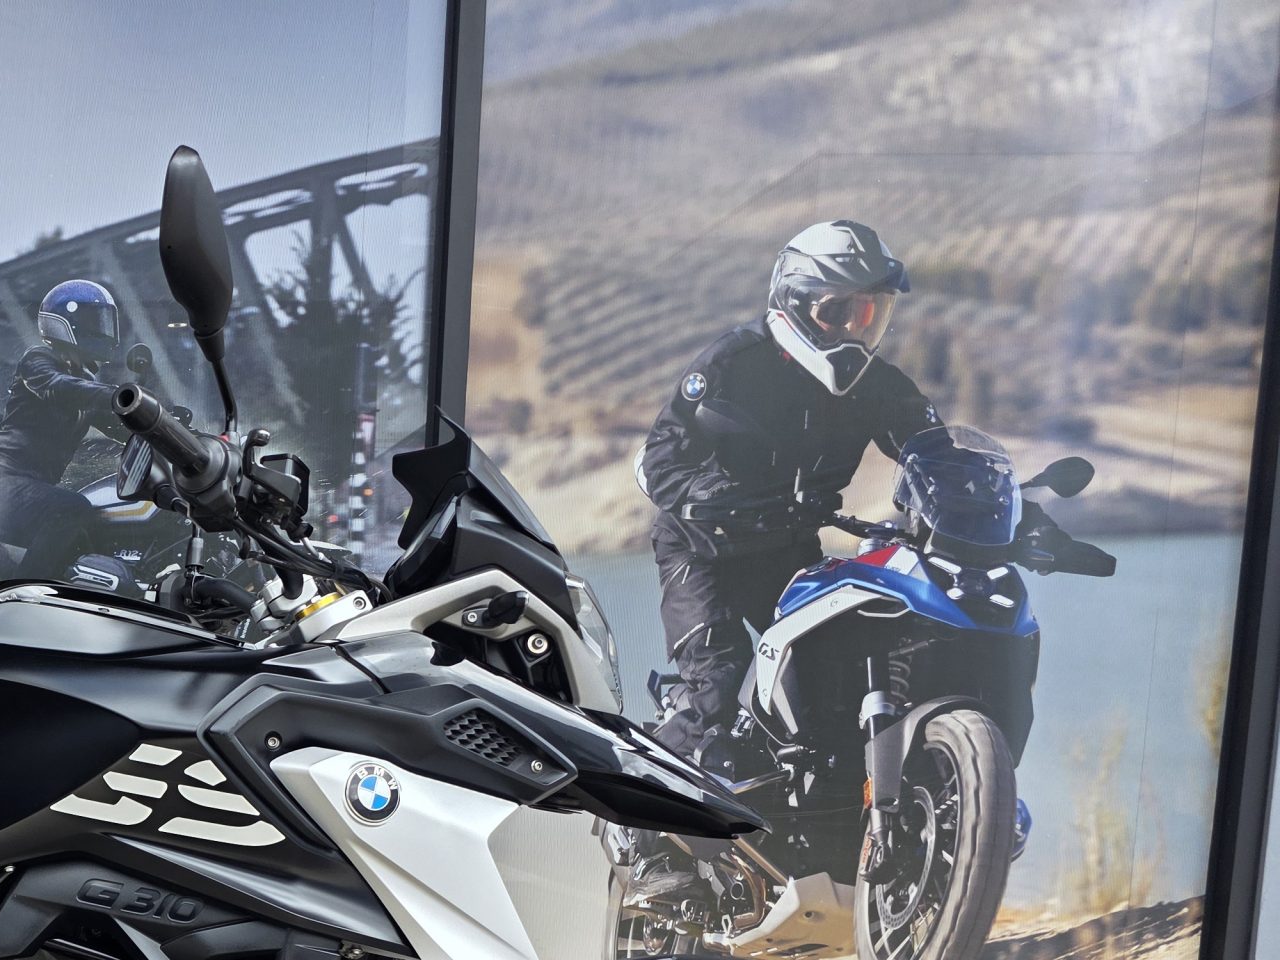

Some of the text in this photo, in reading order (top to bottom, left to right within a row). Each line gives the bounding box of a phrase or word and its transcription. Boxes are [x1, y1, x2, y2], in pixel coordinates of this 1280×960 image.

[50, 743, 286, 847] GS
[356, 766, 399, 790] BMW
[76, 878, 202, 924] G 310
